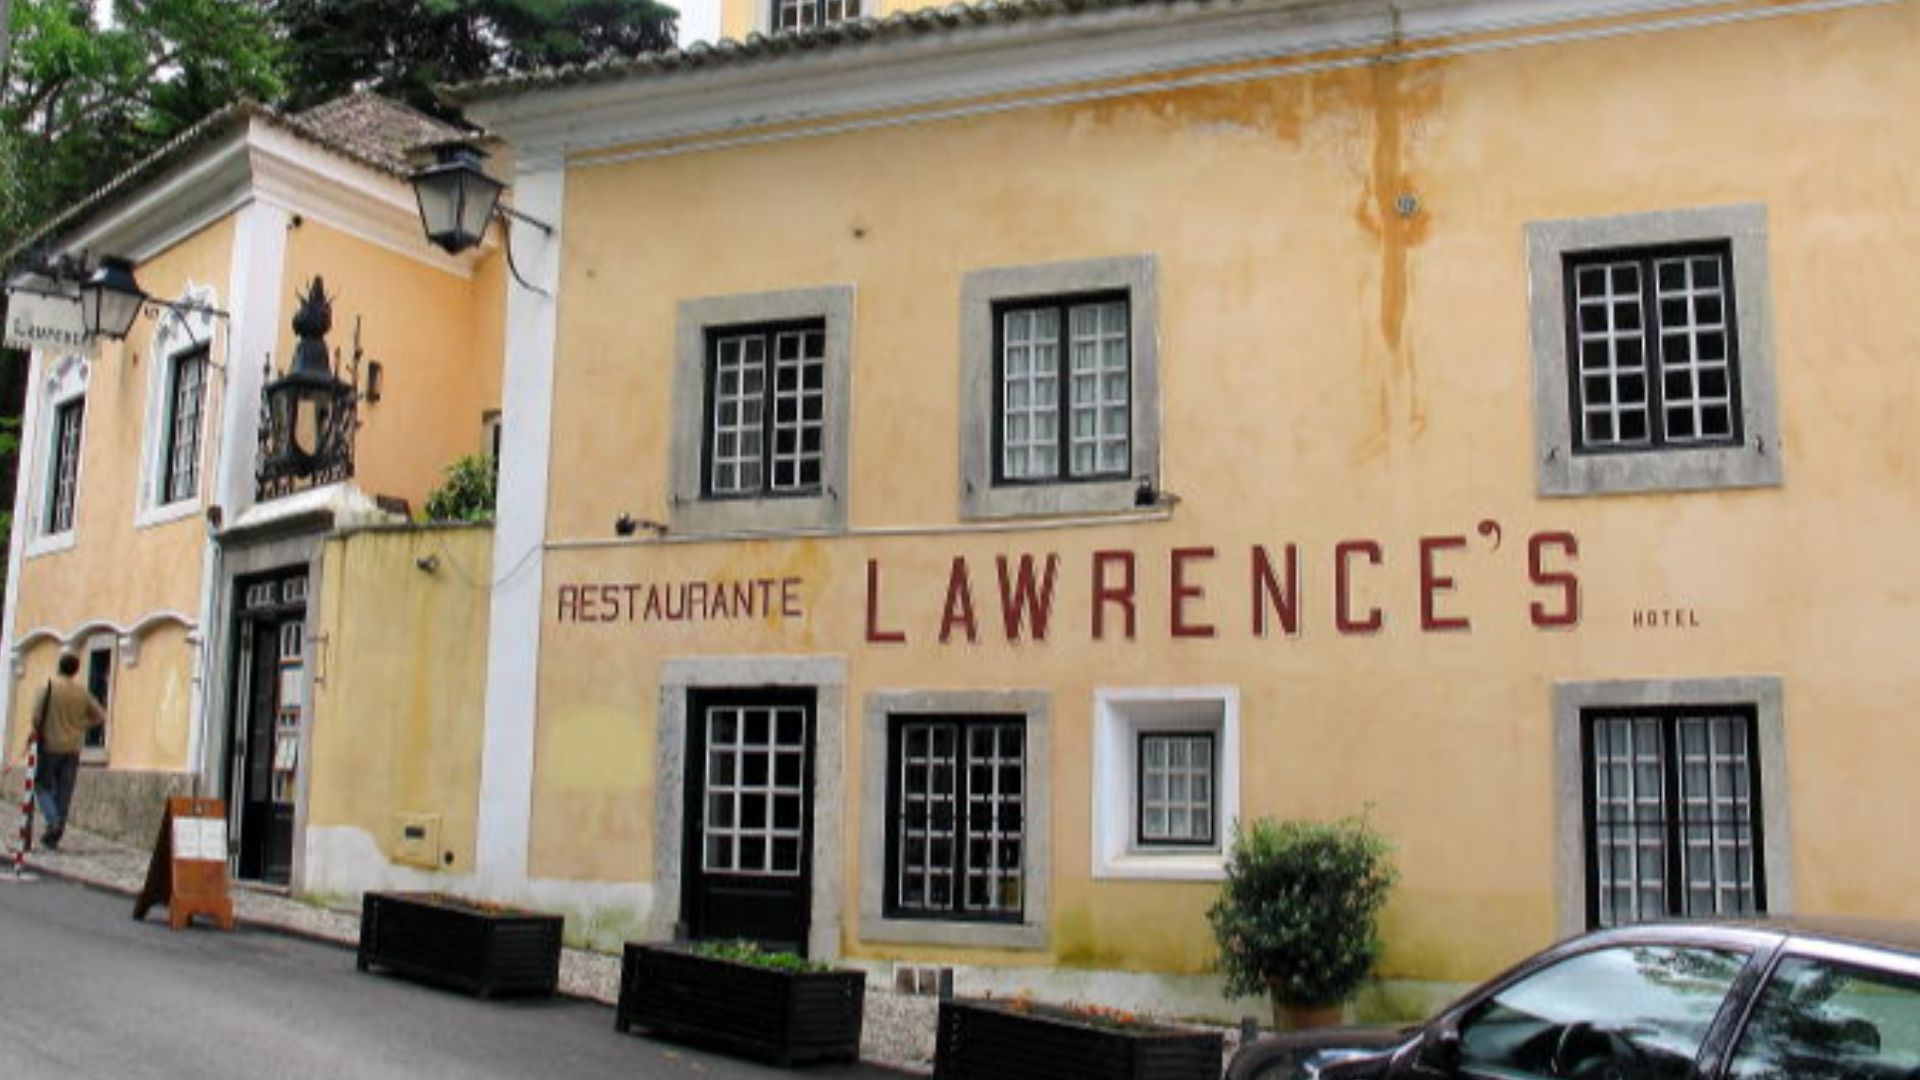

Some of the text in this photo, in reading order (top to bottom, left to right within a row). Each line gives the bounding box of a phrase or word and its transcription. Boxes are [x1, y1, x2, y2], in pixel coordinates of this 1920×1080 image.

[557, 519, 1700, 645] RESTAURANTE LAWRENCE'S HOTEL
